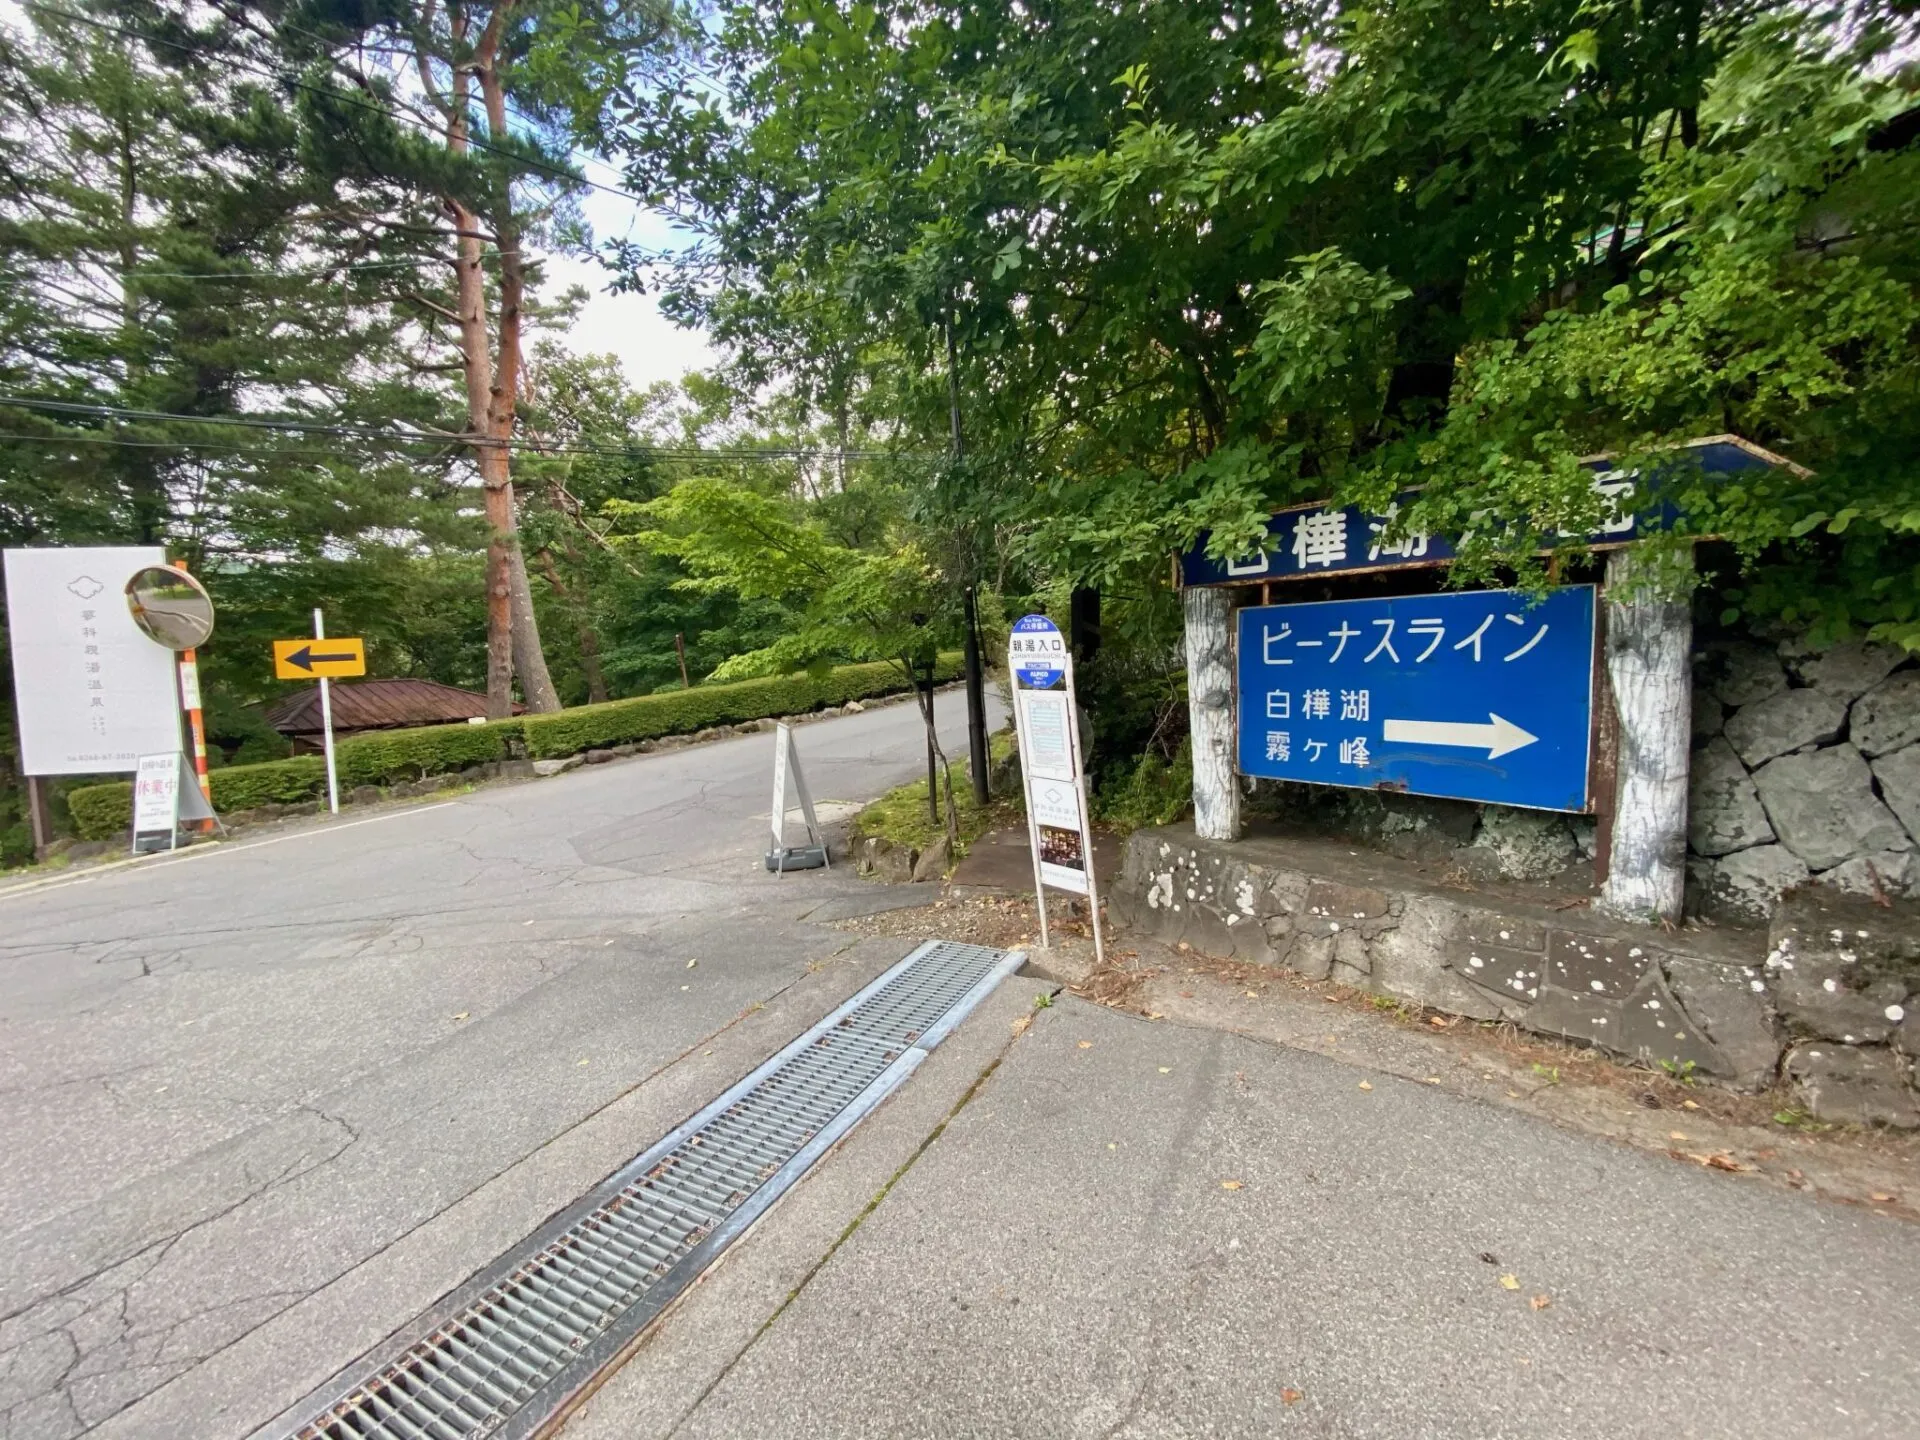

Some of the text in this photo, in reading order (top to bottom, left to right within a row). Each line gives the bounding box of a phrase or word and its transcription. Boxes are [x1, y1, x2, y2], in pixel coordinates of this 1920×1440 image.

[1012, 639, 1061, 652] 親湯入口
[1262, 613, 1550, 666] ビーナスライン
[1266, 688, 1371, 722] 白樺湖
[136, 778, 177, 796] 休業中
